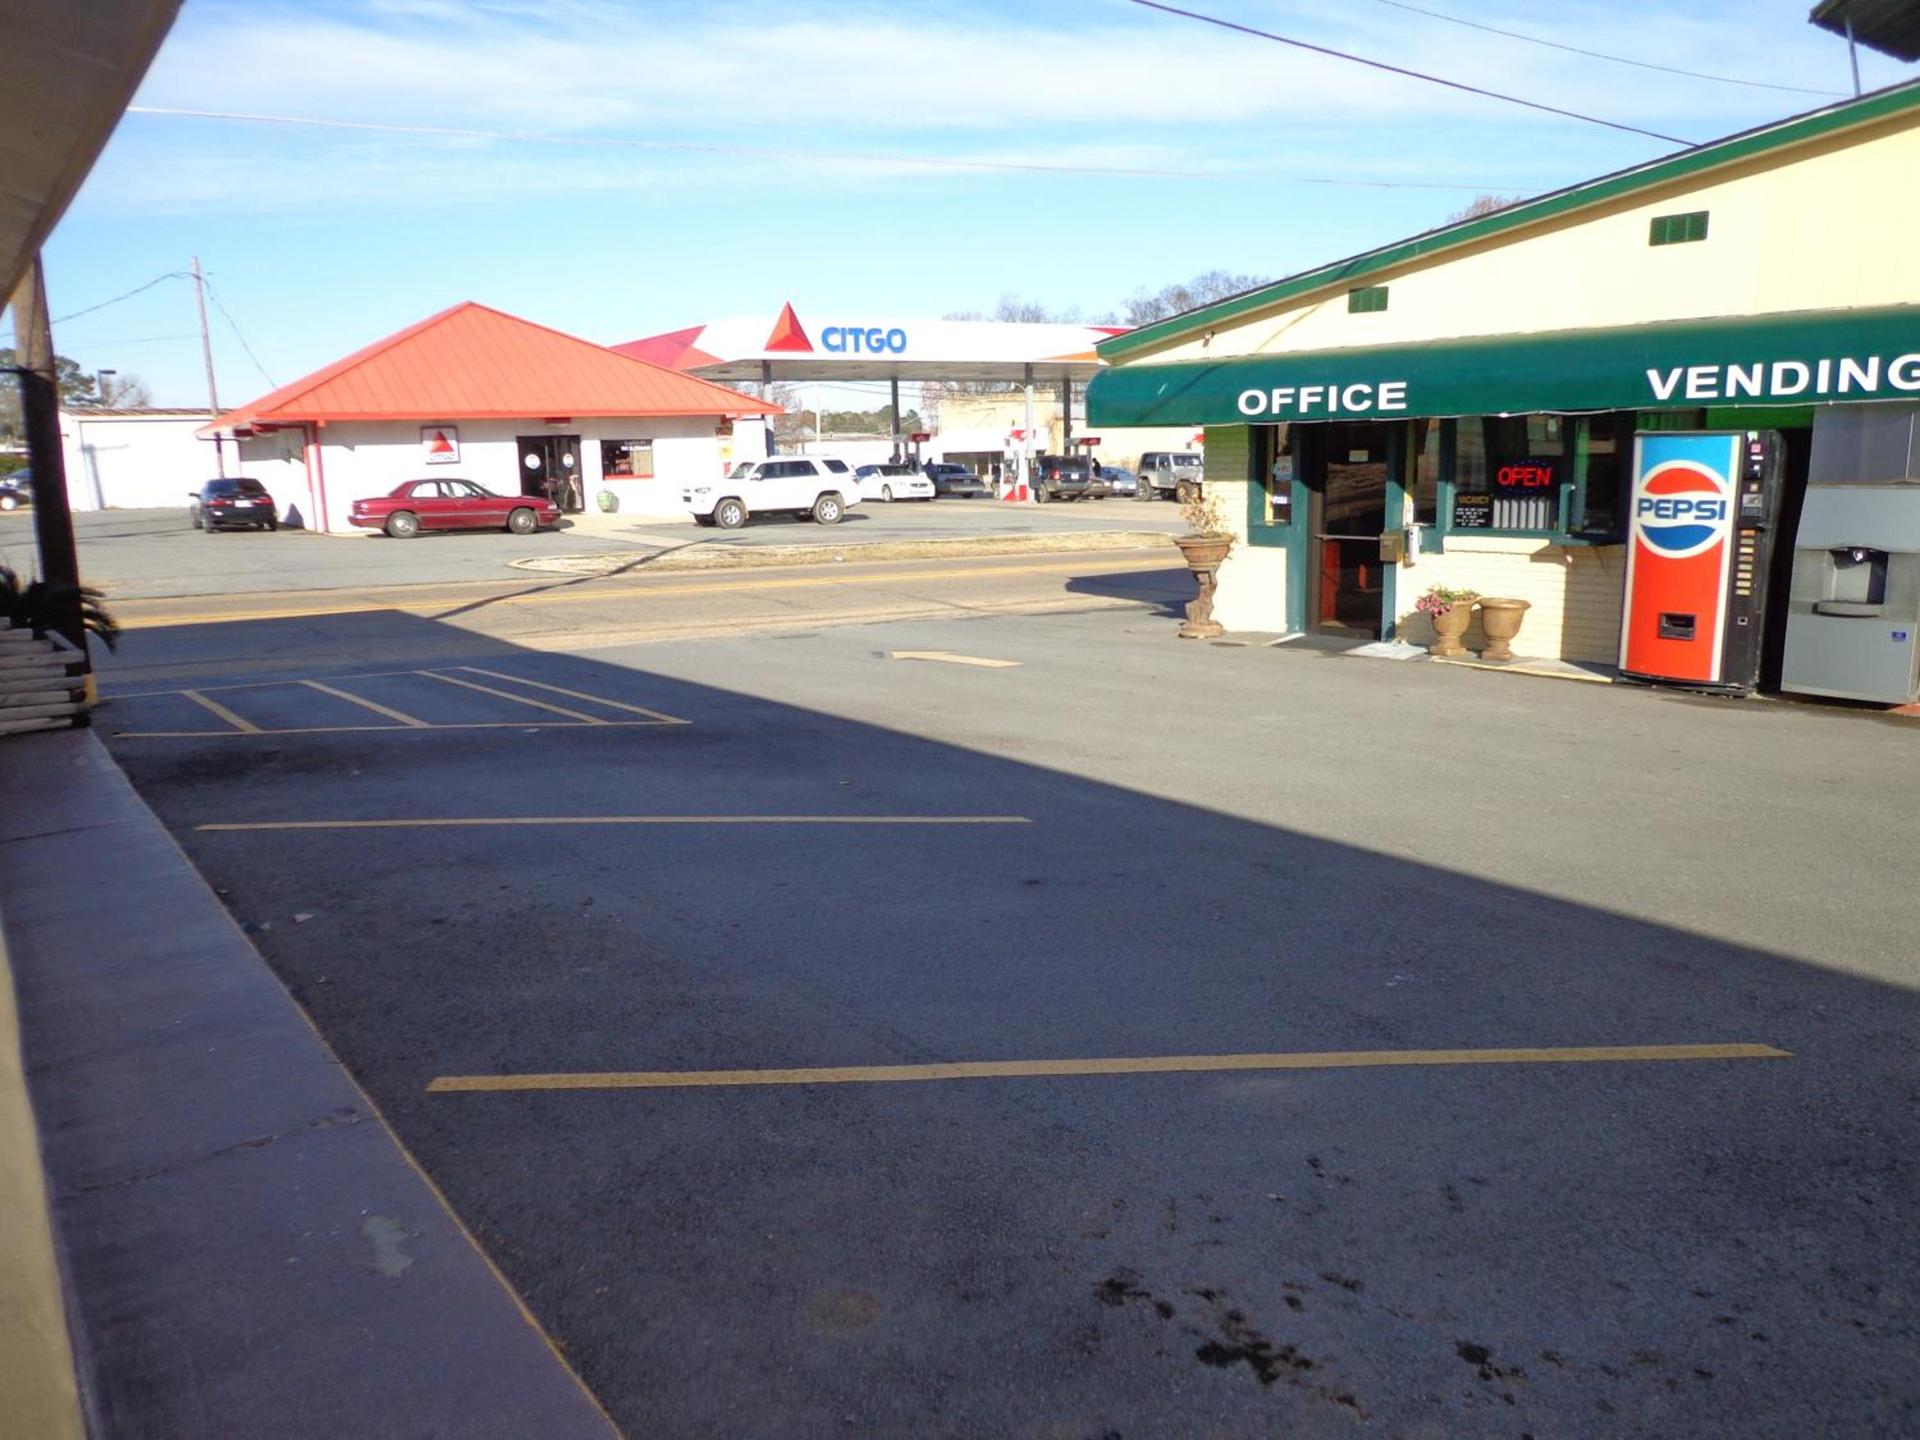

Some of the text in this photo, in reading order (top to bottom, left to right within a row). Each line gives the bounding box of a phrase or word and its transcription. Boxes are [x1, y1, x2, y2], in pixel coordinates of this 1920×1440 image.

[821, 326, 907, 353] CITGO
[1646, 353, 1920, 400] VENDING
[1237, 381, 1407, 415] OFFICE
[1497, 467, 1553, 486] OPEN
[1637, 498, 1727, 520] PEPSI
